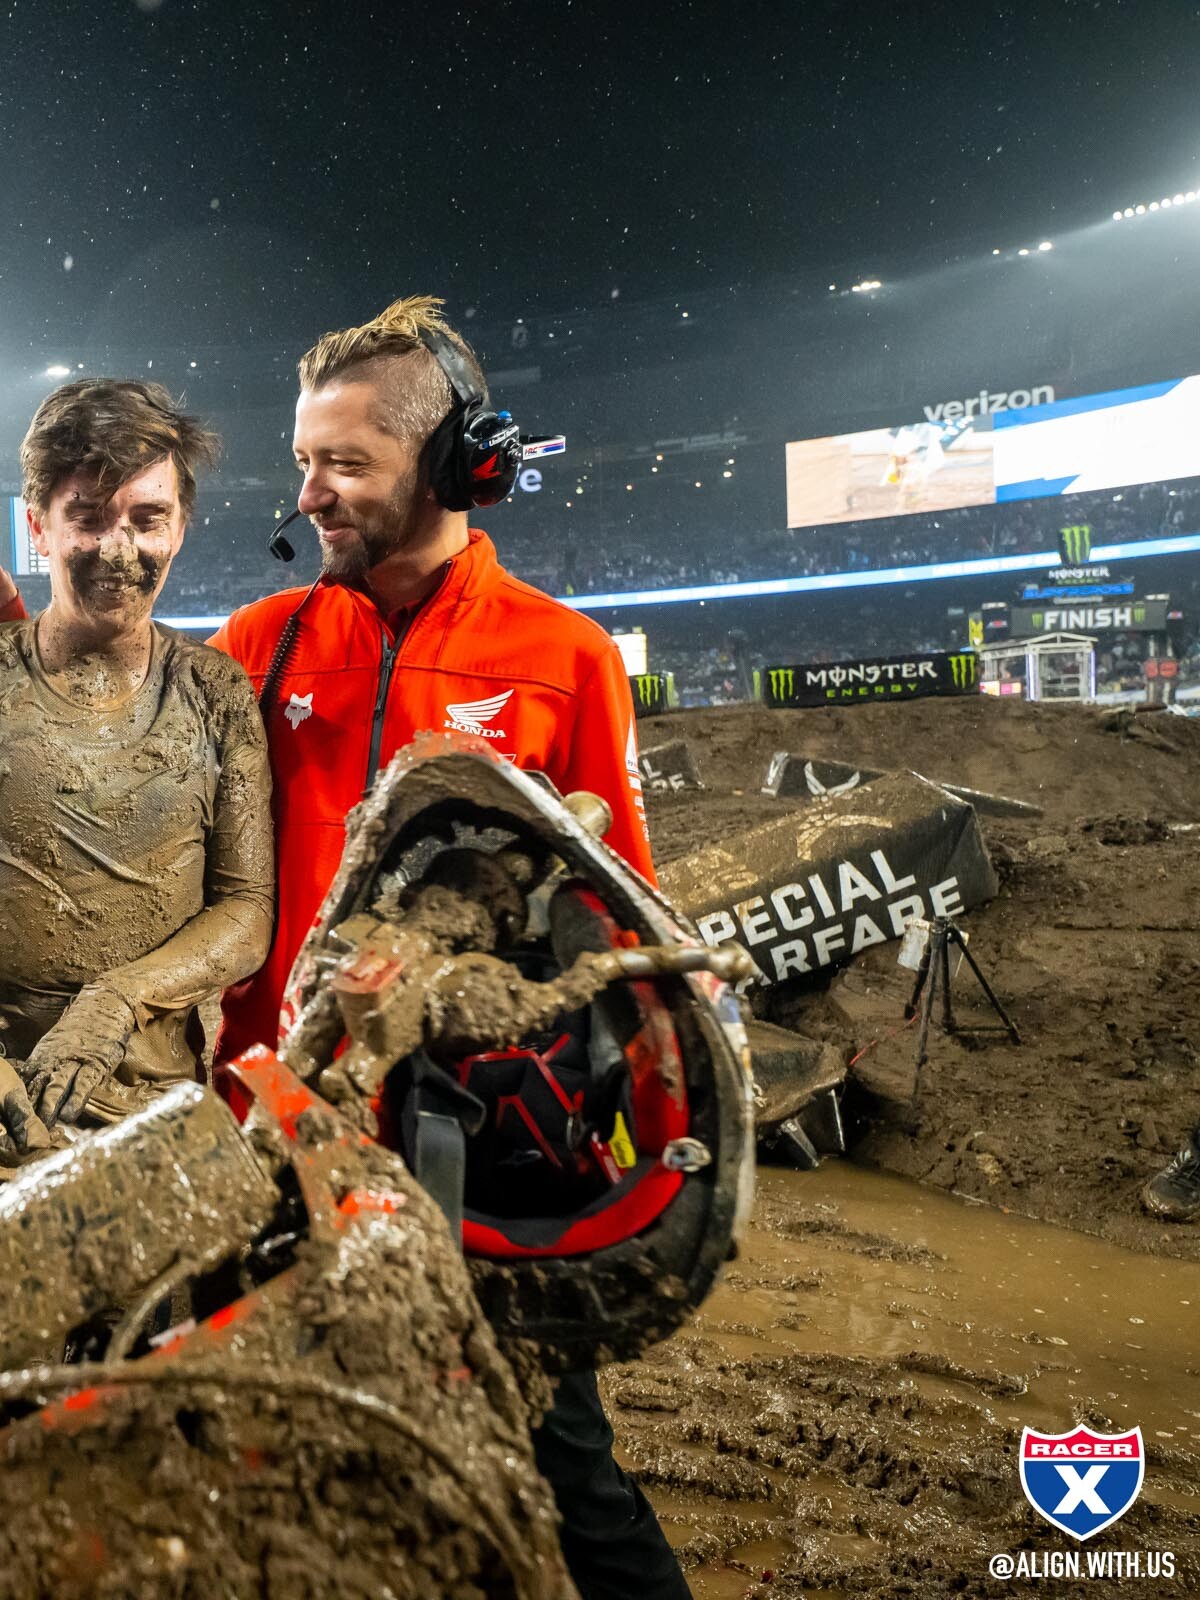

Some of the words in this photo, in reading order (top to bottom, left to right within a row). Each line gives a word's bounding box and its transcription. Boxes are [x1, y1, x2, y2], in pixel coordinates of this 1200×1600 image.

[923, 385, 1055, 423] verizon
[1049, 566, 1110, 580] MONSTER
[1044, 607, 1132, 630] FINISH
[806, 661, 938, 688] MONSTER
[826, 682, 918, 698] ENERGY
[443, 719, 506, 738] HONDA
[695, 850, 917, 947] PECIAL
[735, 876, 966, 995] RFARE
